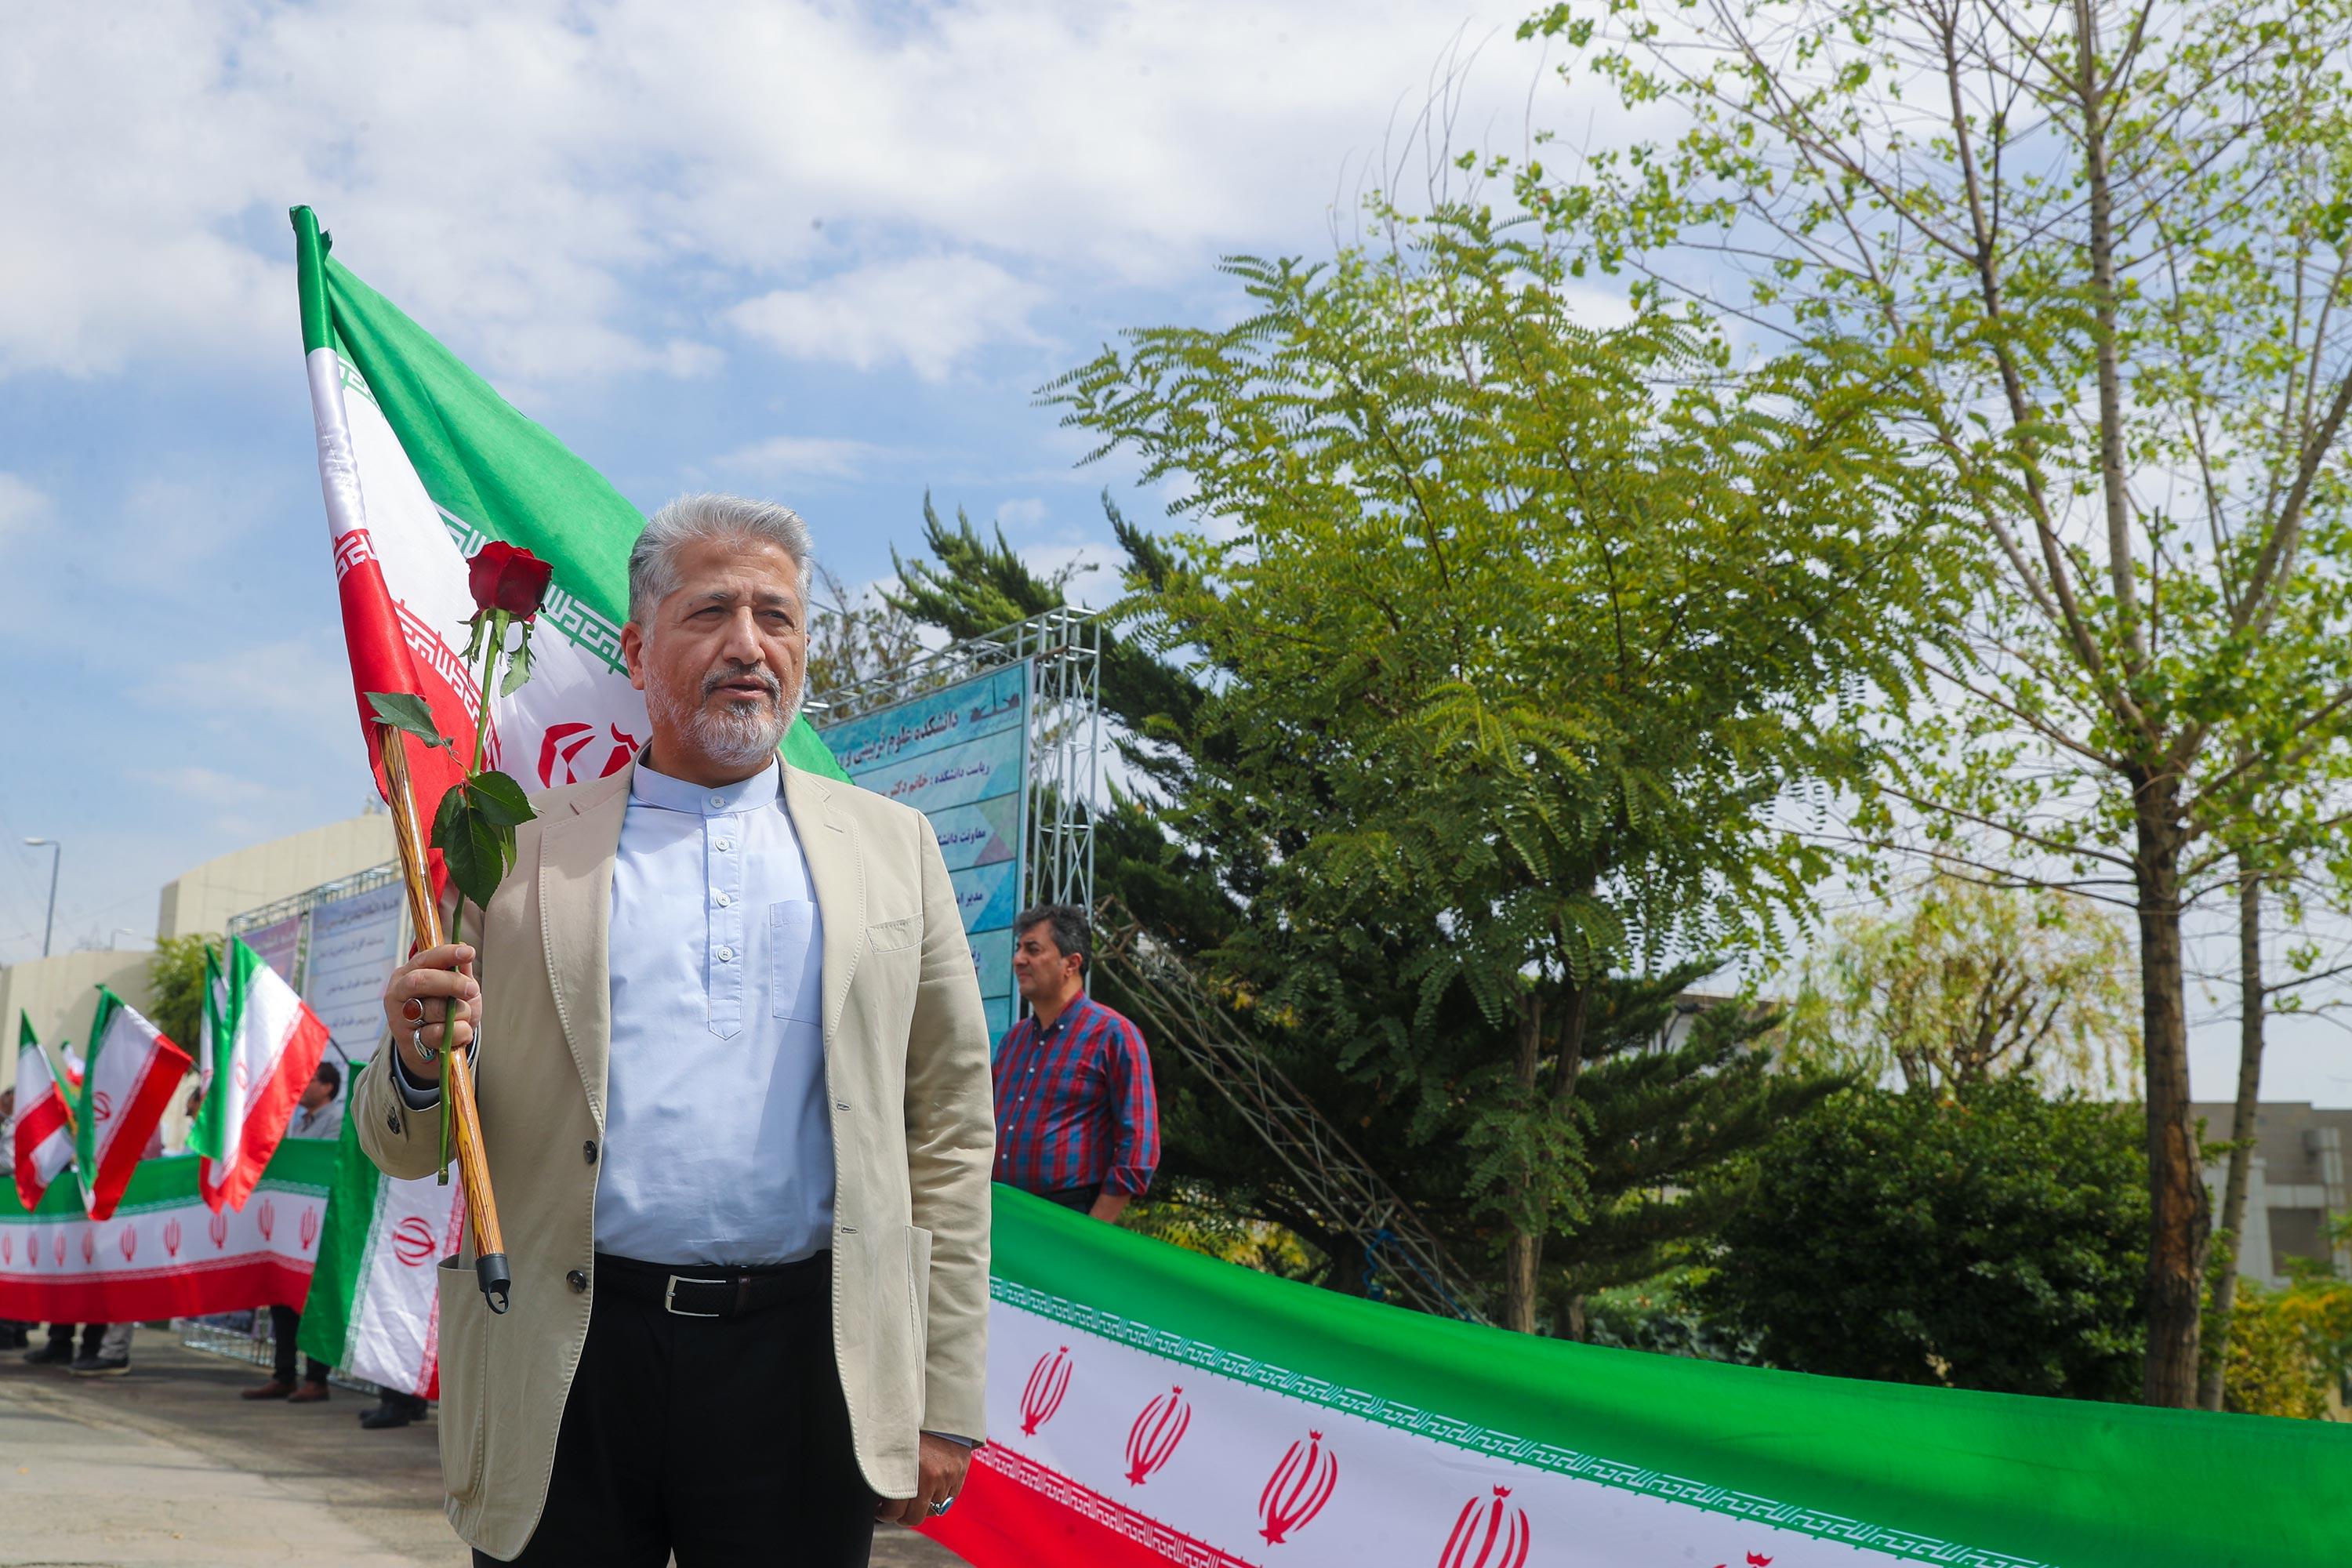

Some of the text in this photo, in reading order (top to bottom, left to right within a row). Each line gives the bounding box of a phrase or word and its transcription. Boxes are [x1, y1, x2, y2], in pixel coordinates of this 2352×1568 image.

[914, 710, 958, 741] دانشکده
[886, 725, 910, 755] علوم
[966, 760, 989, 775] ریاست
[960, 827, 985, 844] معاونت
[965, 891, 983, 907] مدیر
